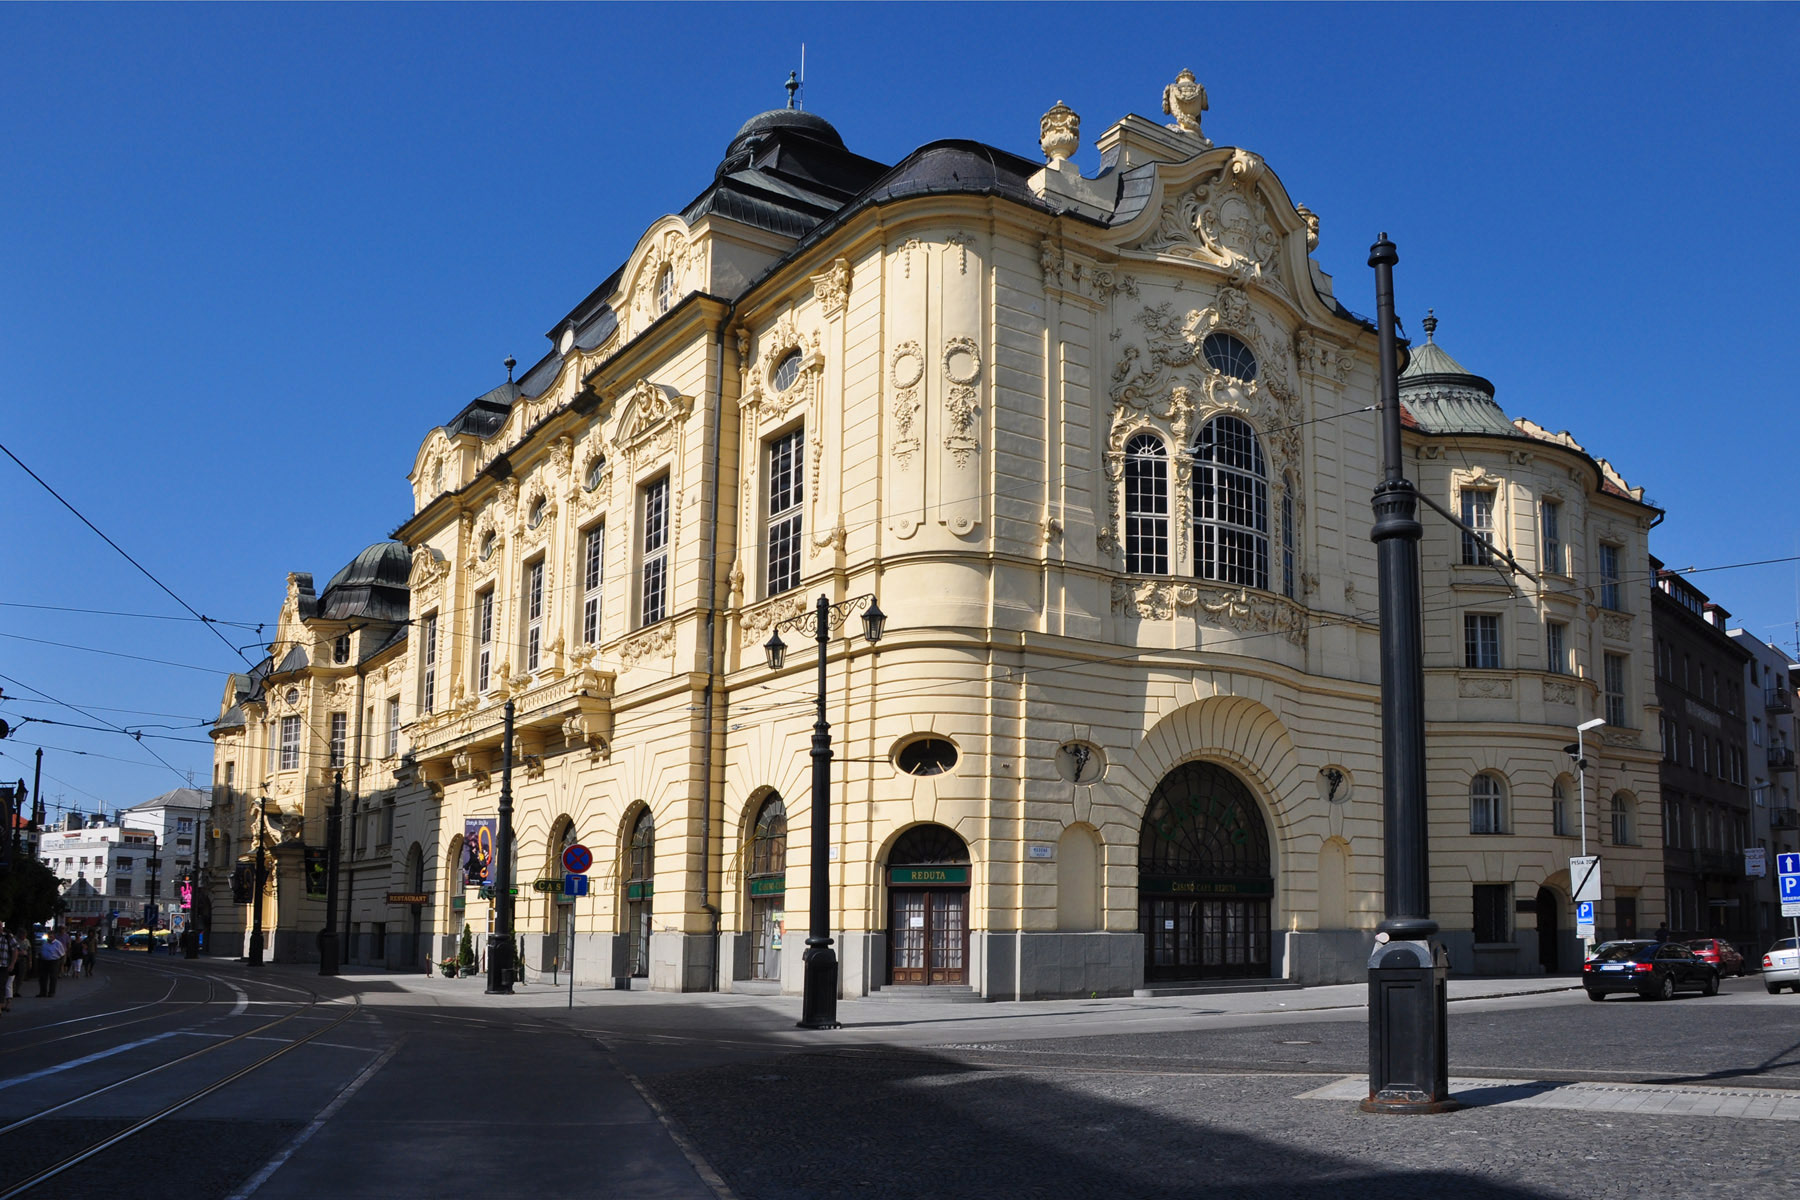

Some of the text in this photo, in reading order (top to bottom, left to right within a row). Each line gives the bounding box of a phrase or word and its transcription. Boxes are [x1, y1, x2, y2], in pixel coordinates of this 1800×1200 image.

[1158, 794, 1248, 845] CASINO
[911, 871, 946, 880] REDUTA
[1785, 877, 1797, 894] P
[1580, 904, 1589, 917] P
